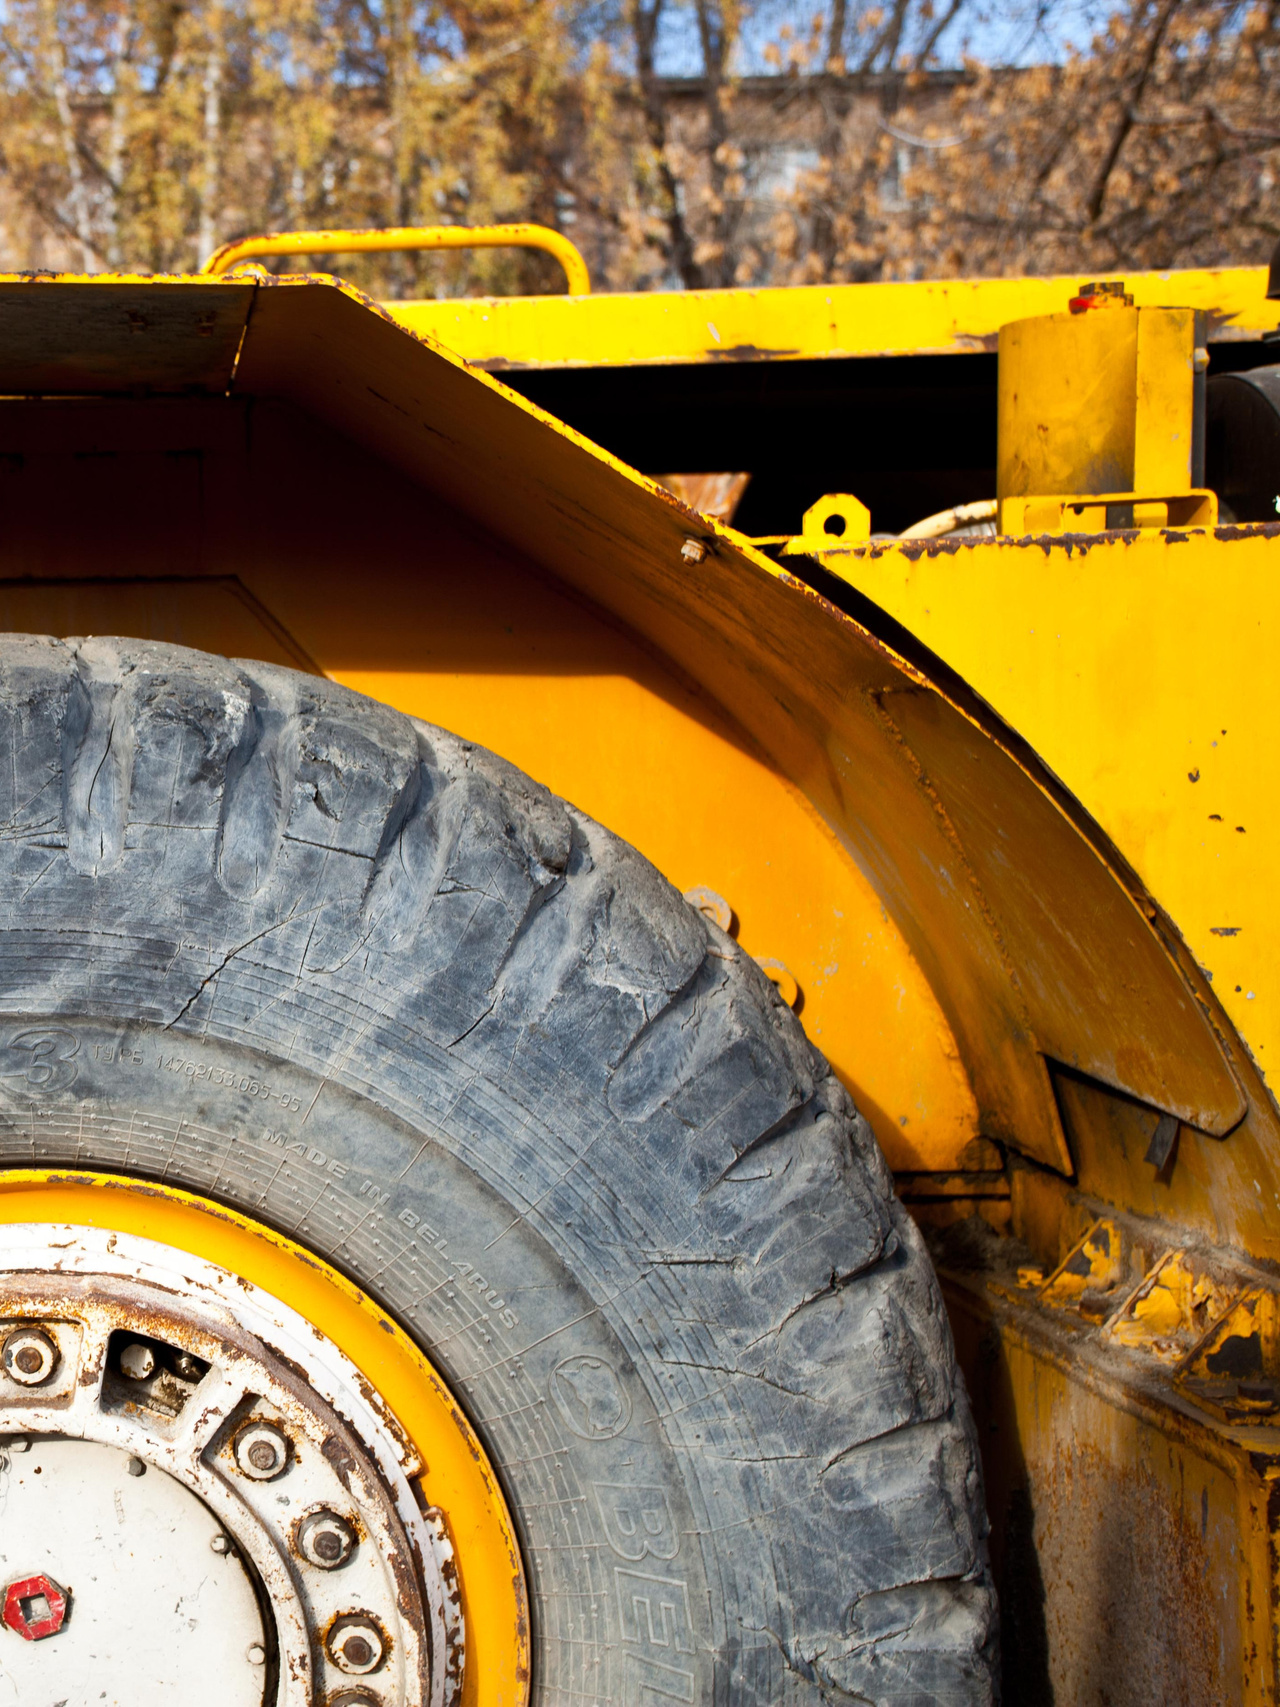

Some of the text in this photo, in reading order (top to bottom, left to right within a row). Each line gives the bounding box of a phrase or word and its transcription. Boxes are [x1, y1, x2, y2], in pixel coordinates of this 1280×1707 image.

[92, 1044, 115, 1064] ТУ
[120, 1048, 144, 1066] РБ
[262, 1128, 520, 1330] MADE IN BELARUS
